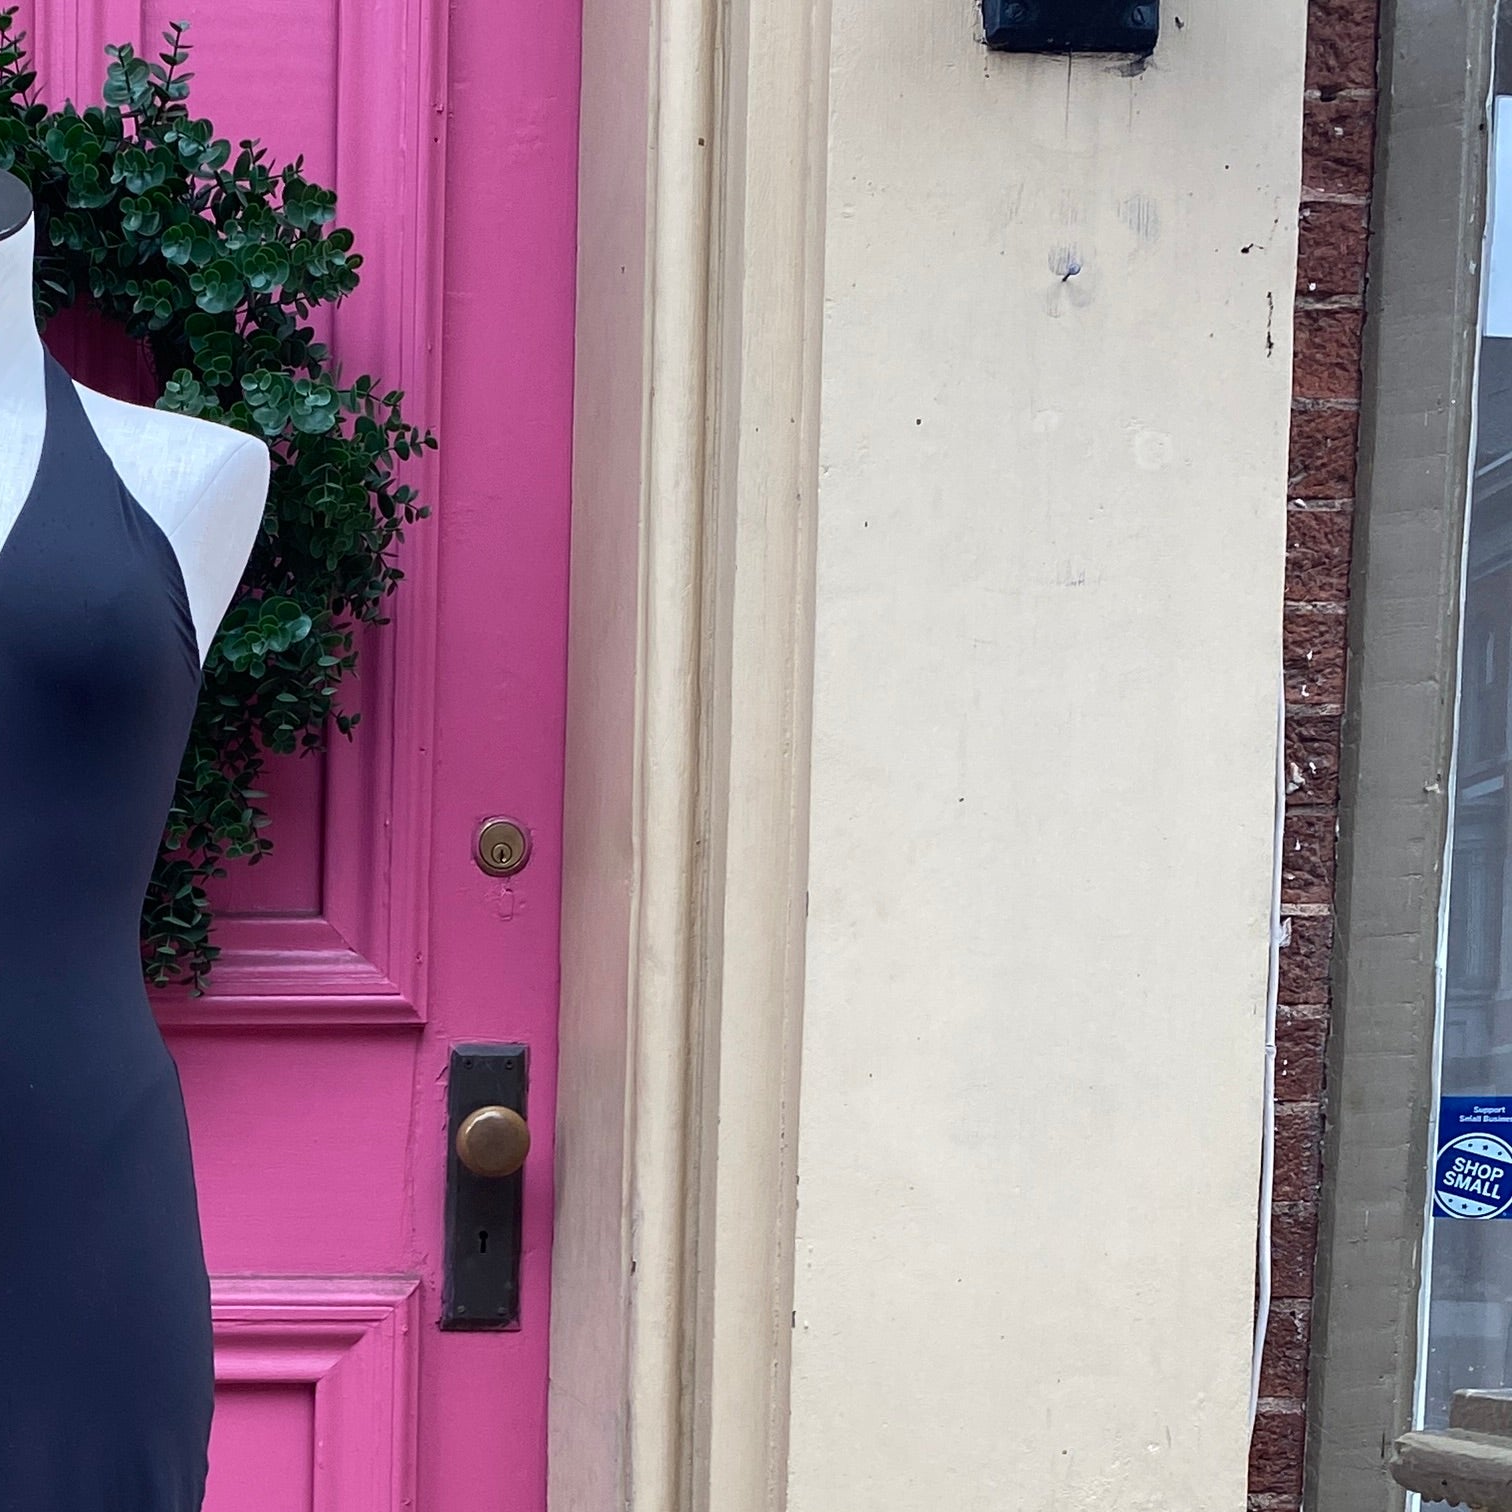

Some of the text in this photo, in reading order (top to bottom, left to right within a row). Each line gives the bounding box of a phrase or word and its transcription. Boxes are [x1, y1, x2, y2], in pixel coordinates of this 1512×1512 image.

[1473, 1106, 1506, 1114] Support
[1452, 1157, 1504, 1182] SHOP
[1443, 1171, 1501, 1199] SMALL
